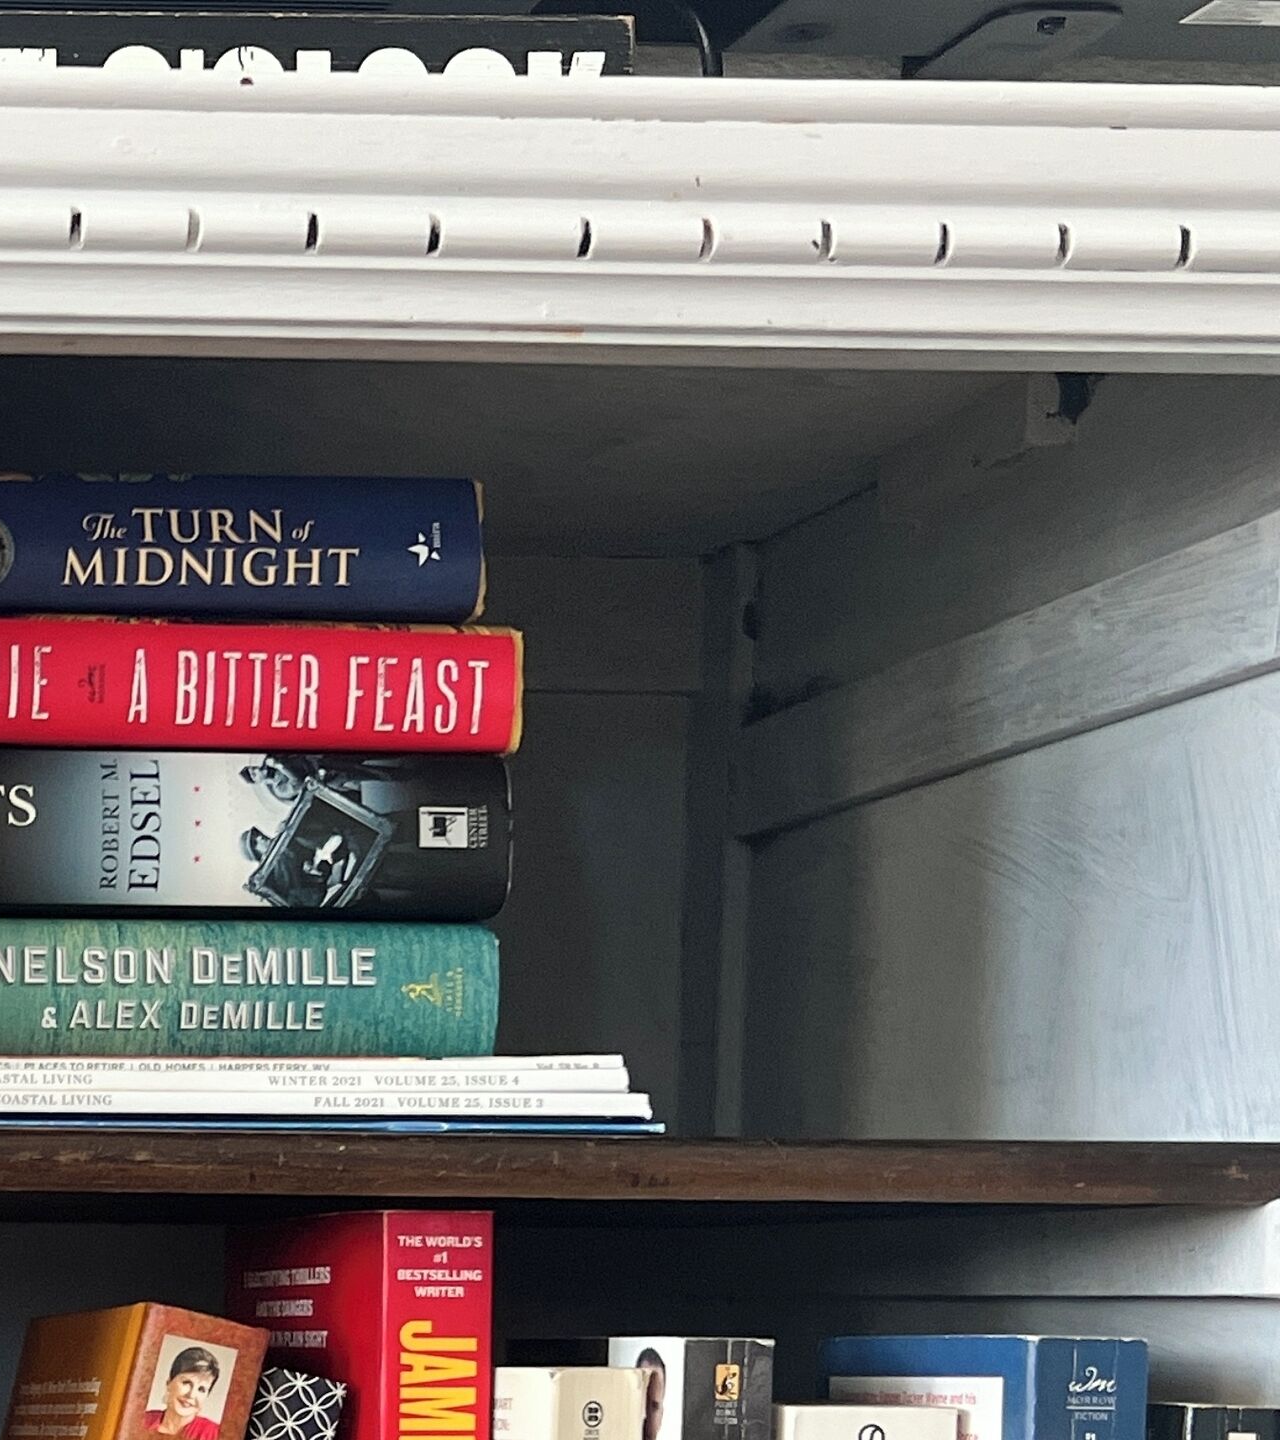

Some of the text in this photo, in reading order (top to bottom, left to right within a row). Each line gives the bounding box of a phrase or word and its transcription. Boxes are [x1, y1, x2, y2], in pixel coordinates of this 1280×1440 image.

[81, 506, 314, 545] The TURN of
[61, 545, 360, 589] MIDNIGHT
[128, 648, 150, 726] A
[174, 650, 321, 731] BITTER
[344, 654, 491, 737] FEAST
[127, 759, 162, 893] EDSEL
[99, 788, 120, 890] ROBERT
[41, 1005, 58, 1030] &
[69, 1000, 164, 1030] ALEX
[42, 1073, 93, 1085] LIVING
[268, 1075, 328, 1087] WINTER
[332, 1075, 362, 1087] 2021
[375, 1075, 437, 1087] VOLUME
[464, 1075, 508, 1087] ISSUE
[512, 1075, 520, 1087] 4
[61, 1094, 113, 1106] LIVING
[397, 1235, 483, 1248] THE WORLD'S
[433, 1251, 448, 1264] #1
[397, 1269, 482, 1282] BESTSELLING
[414, 1286, 464, 1298] WRITER
